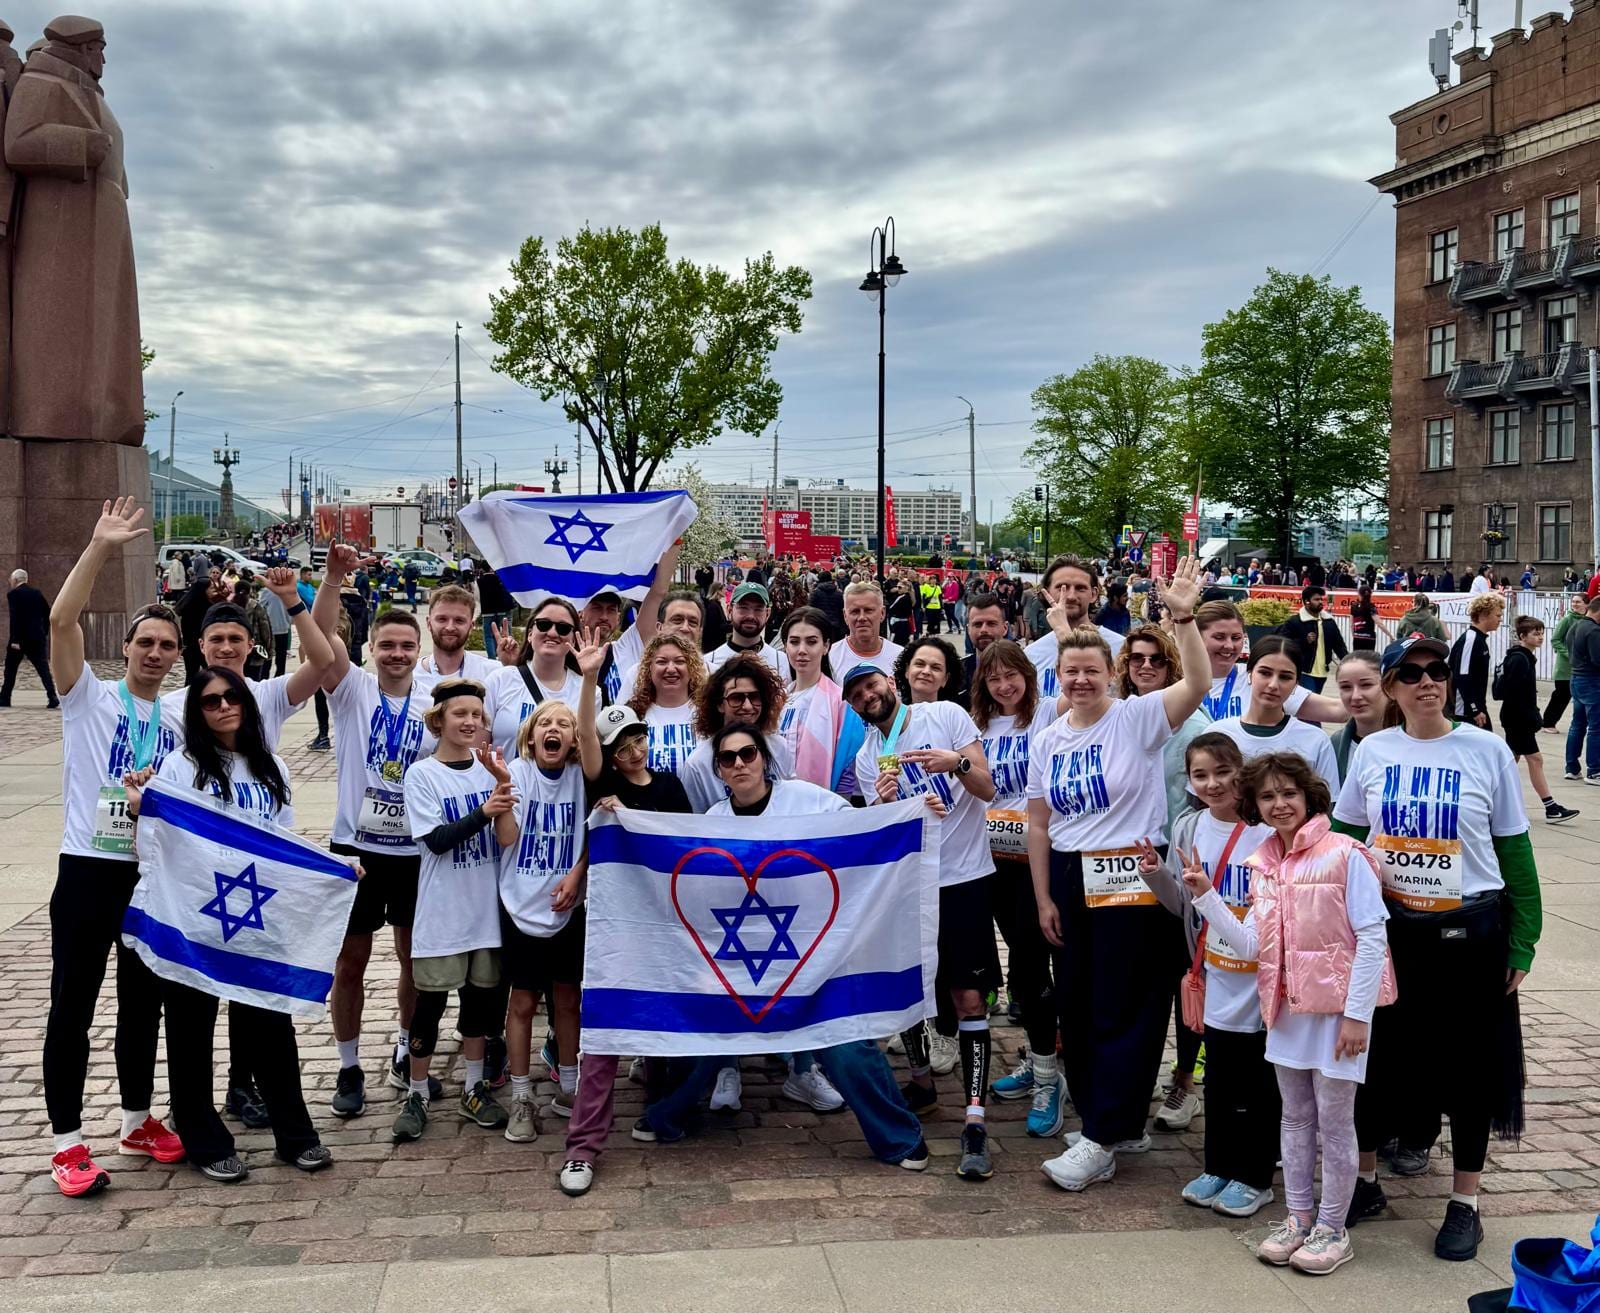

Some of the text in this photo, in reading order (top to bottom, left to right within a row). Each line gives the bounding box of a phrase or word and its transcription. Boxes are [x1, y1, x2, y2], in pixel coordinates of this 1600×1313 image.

[986, 820, 1023, 834] 9948
[990, 838, 1021, 847] ATĀLIJA
[1384, 850, 1452, 870] 30478
[1105, 876, 1140, 885] JULIJA
[1394, 874, 1442, 886] MARINA
